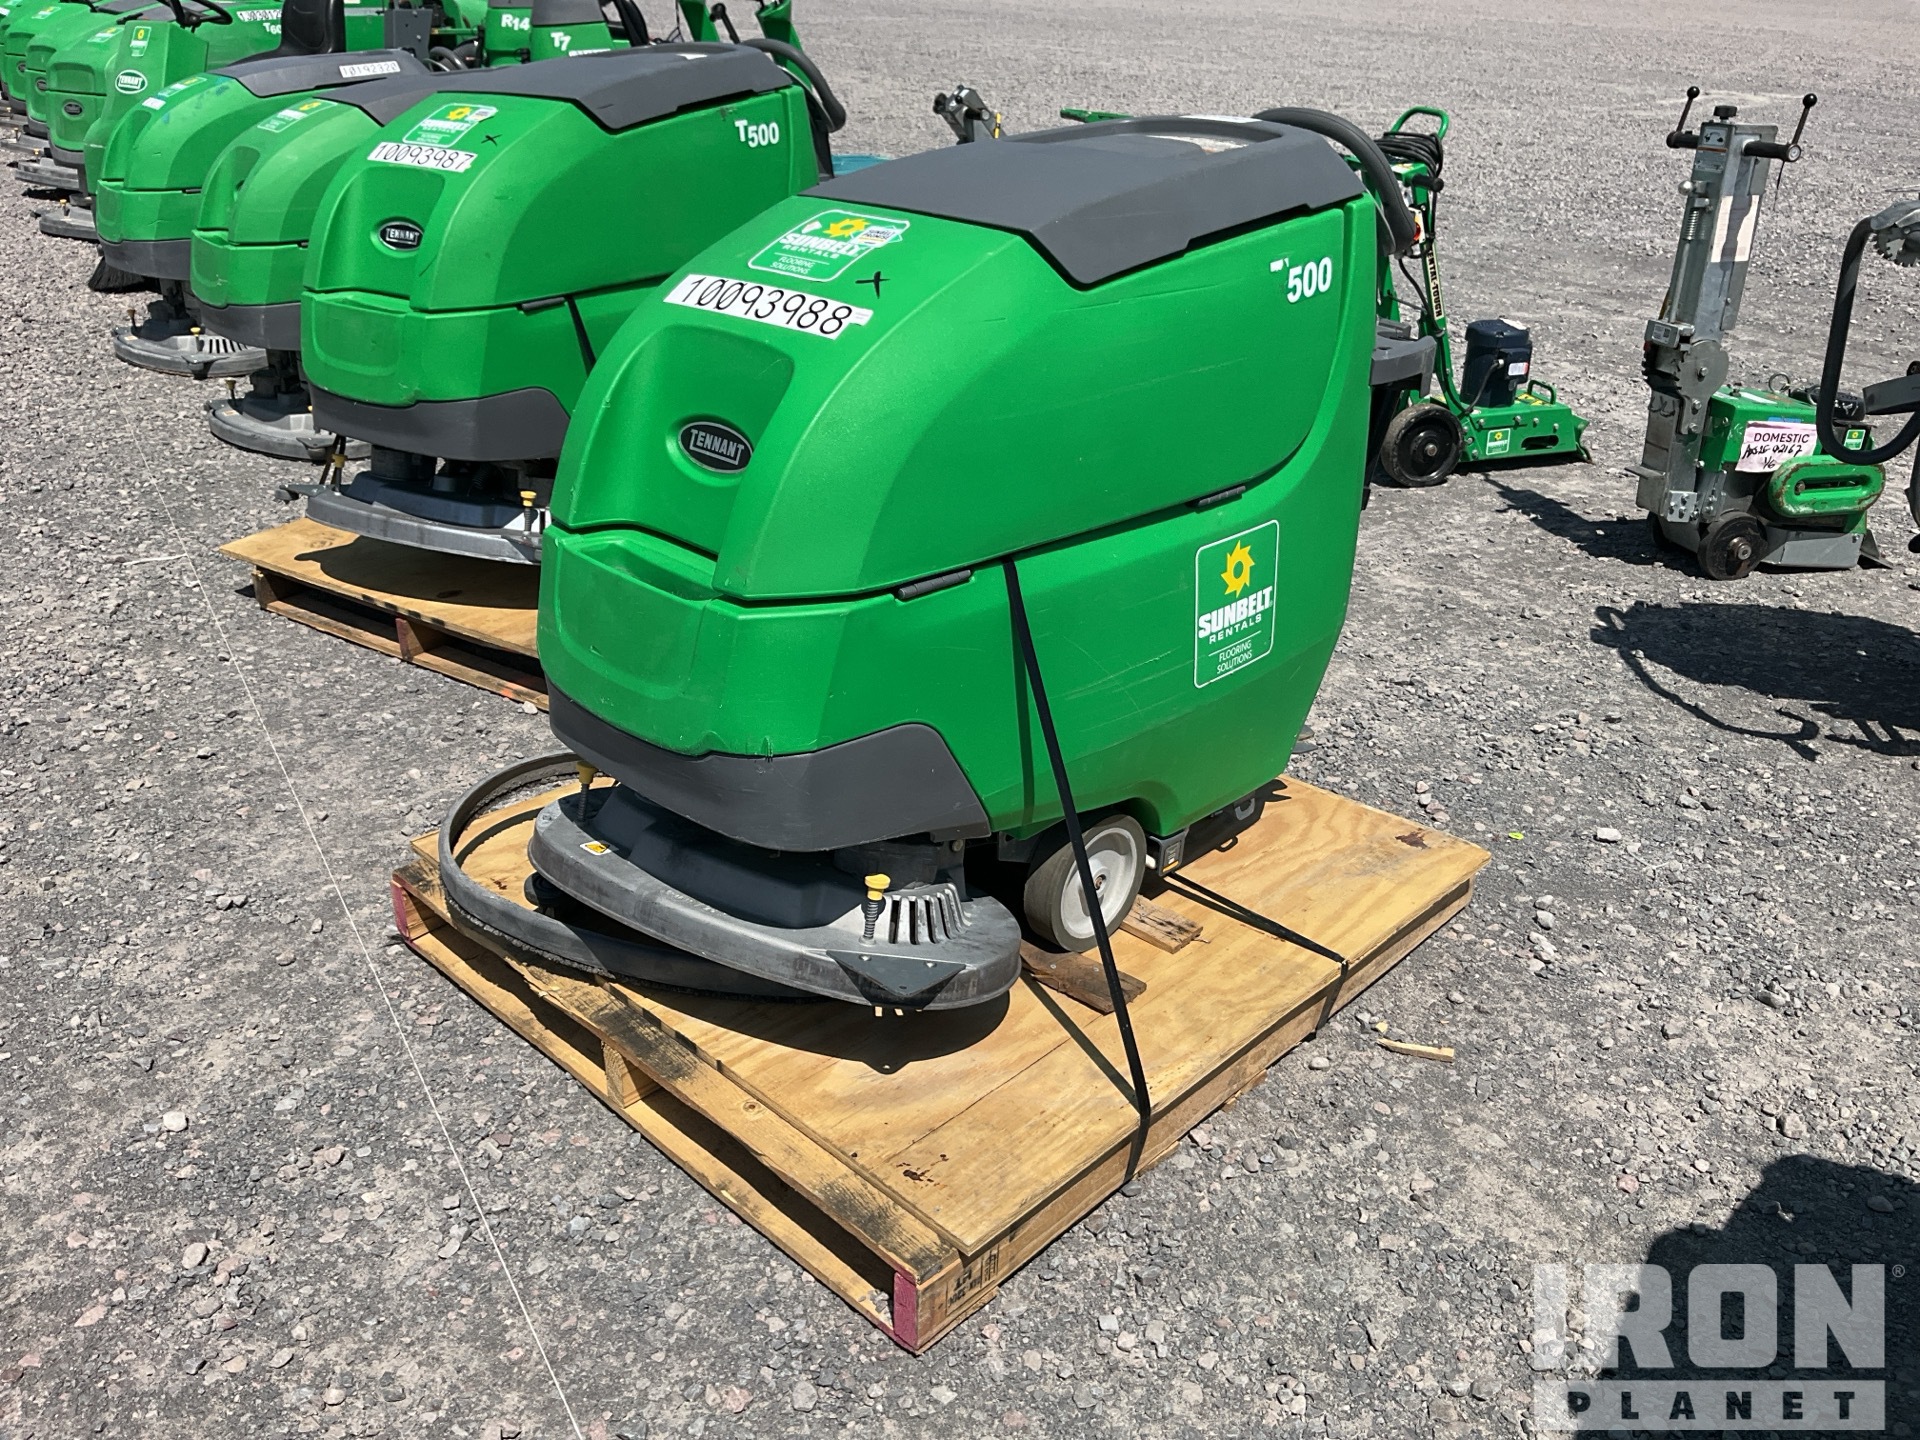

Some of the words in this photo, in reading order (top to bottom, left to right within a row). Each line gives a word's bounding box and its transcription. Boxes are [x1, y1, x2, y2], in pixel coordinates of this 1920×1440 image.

[501, 13, 530, 31] R14
[550, 31, 571, 52] T7
[734, 120, 780, 148] T500
[374, 144, 475, 170] 10093987
[386, 228, 420, 246] TENNANT
[779, 232, 861, 256] SUNBELT
[778, 256, 816, 269] FLOORING
[781, 244, 841, 260] RENTALS
[769, 262, 811, 275] SOLUTIONS
[681, 276, 853, 335] 10093988
[689, 429, 745, 466] TENNANT
[1754, 432, 1810, 444] DOMESTIC
[1198, 585, 1273, 639] SUNBELT
[1209, 613, 1262, 645] RENTALS
[1216, 650, 1253, 674] SOLUTIONS
[1218, 639, 1252, 663] FLOORING
